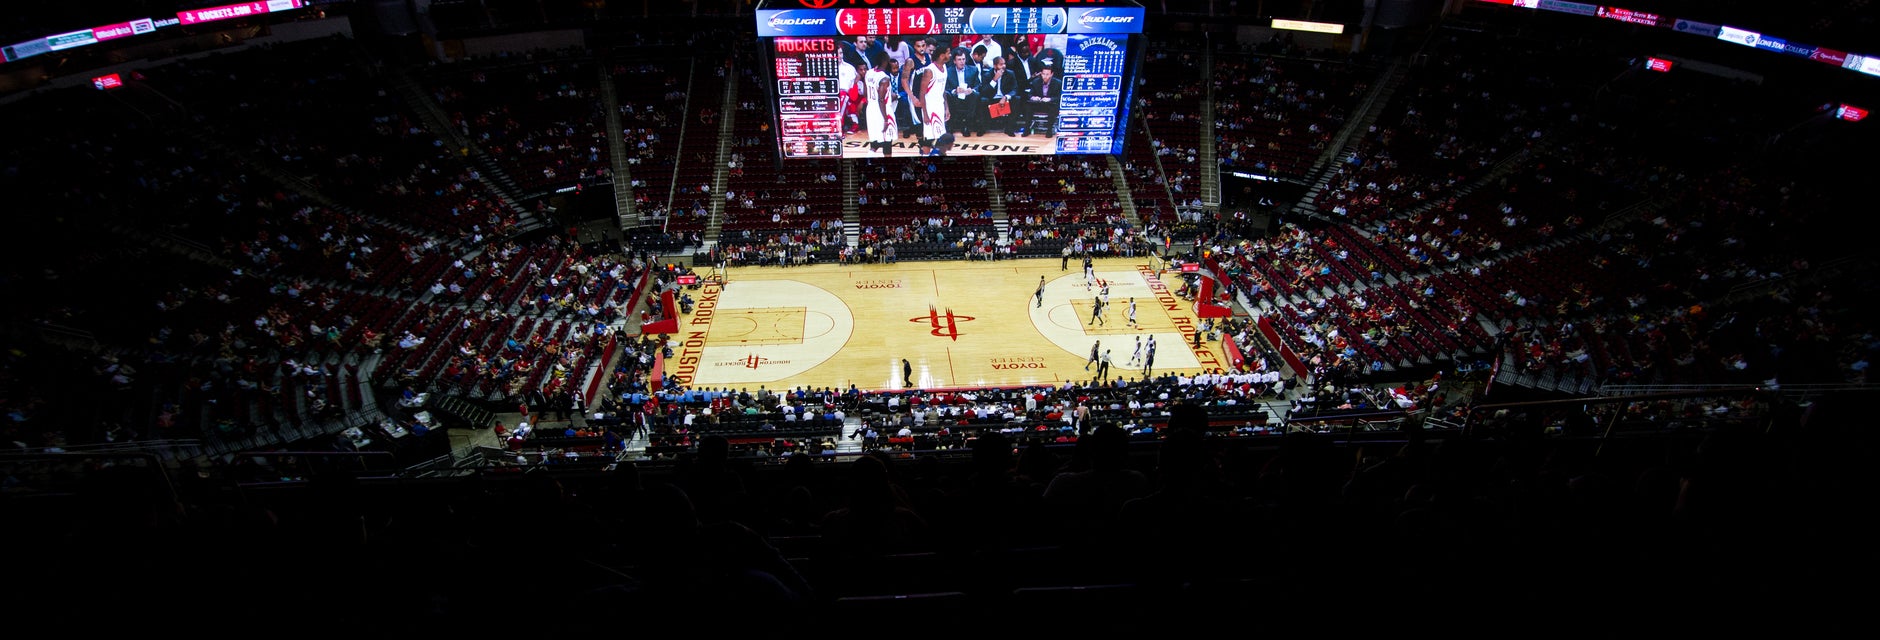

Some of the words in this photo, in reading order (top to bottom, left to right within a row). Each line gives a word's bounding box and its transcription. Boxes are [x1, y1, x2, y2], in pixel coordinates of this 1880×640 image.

[198, 5, 251, 20] ROCKETS.COM
[944, 8, 964, 18] 5:52
[1083, 15, 1105, 23] BUD
[1104, 15, 1134, 23] LIGHT
[908, 14, 926, 29] 14
[991, 14, 1000, 28] 7
[777, 38, 835, 52] ROCKETS
[1757, 38, 1772, 48] LONE
[1771, 40, 1785, 50] STAR
[1784, 44, 1810, 55] COLLEGE
[1136, 264, 1184, 311] HOUSTON
[1171, 316, 1226, 375] ROCKETS
[675, 331, 706, 387] OUSTON
